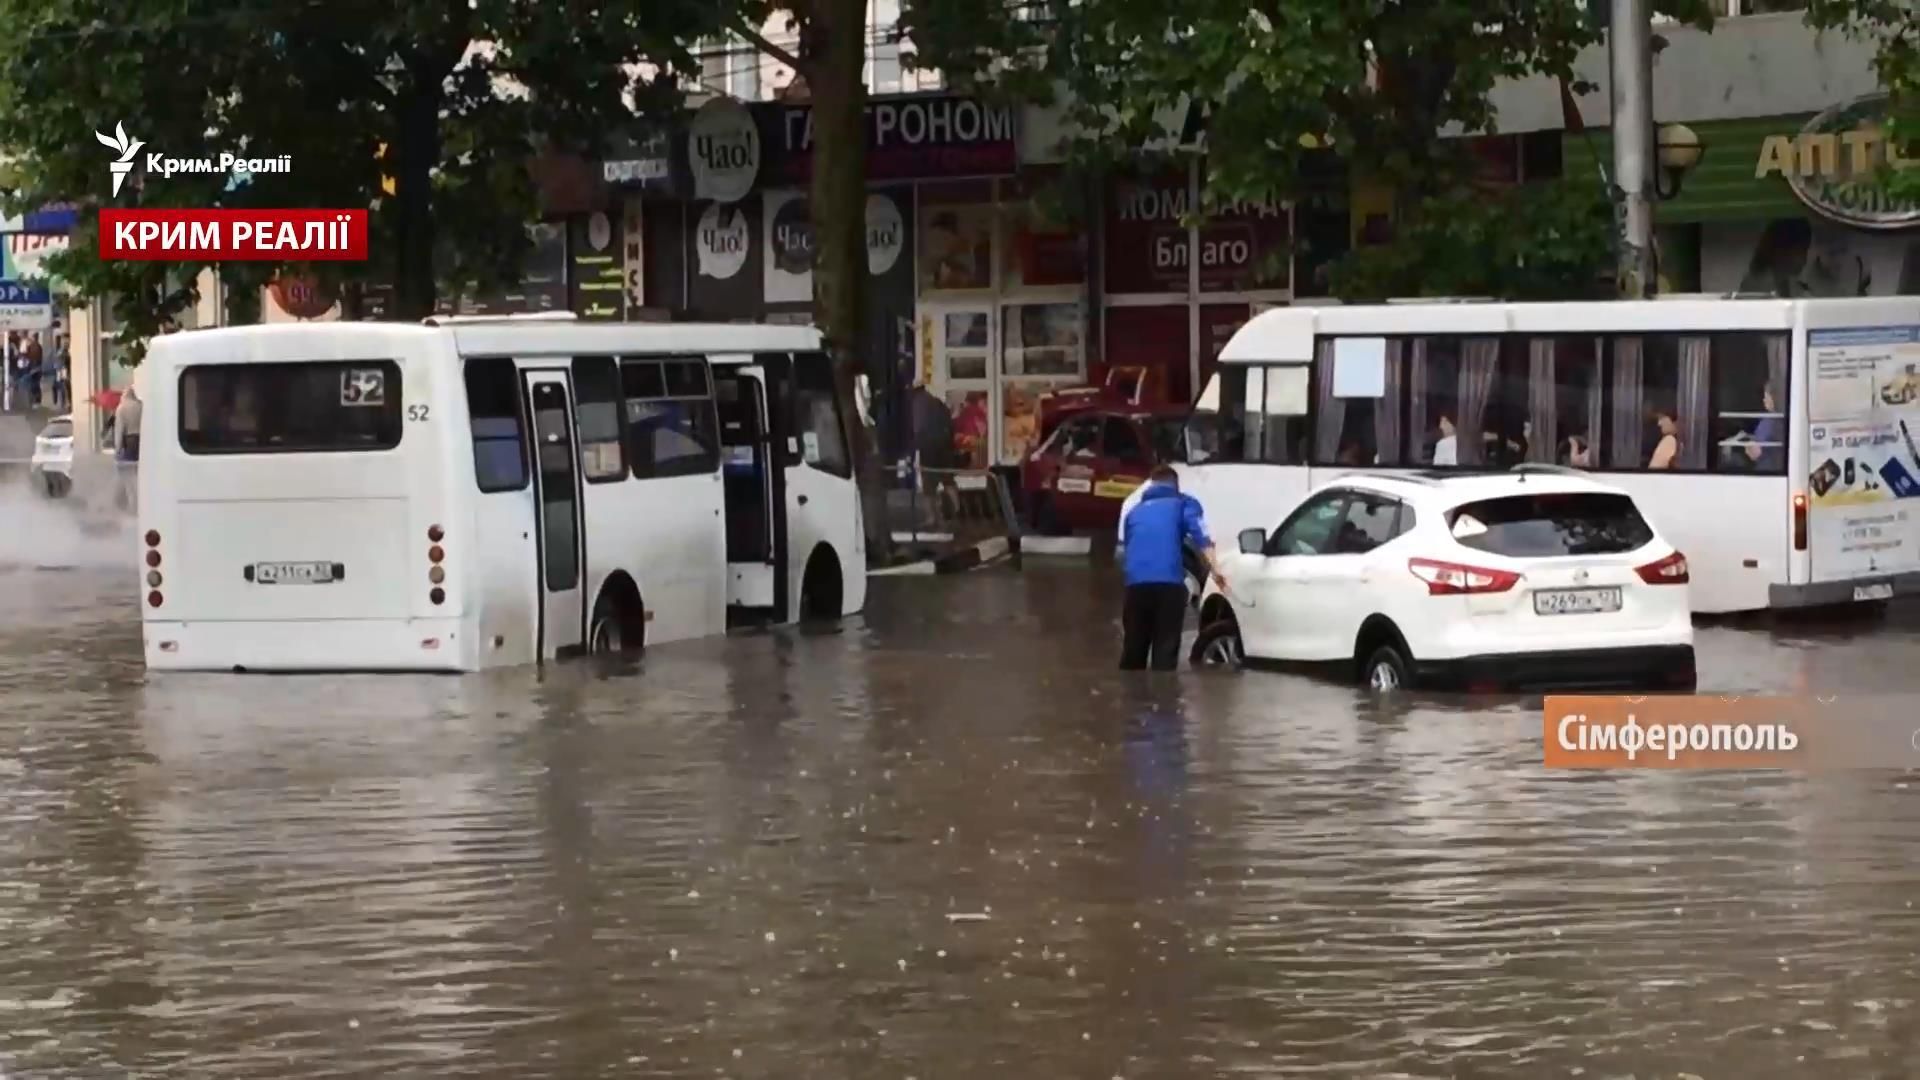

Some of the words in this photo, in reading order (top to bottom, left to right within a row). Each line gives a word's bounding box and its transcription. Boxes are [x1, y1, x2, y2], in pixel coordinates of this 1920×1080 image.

[696, 132, 753, 169] Чао!
[703, 228, 744, 254] Чао!
[1156, 236, 1249, 267] Благо
[343, 369, 384, 402] 52
[408, 404, 430, 422] 52
